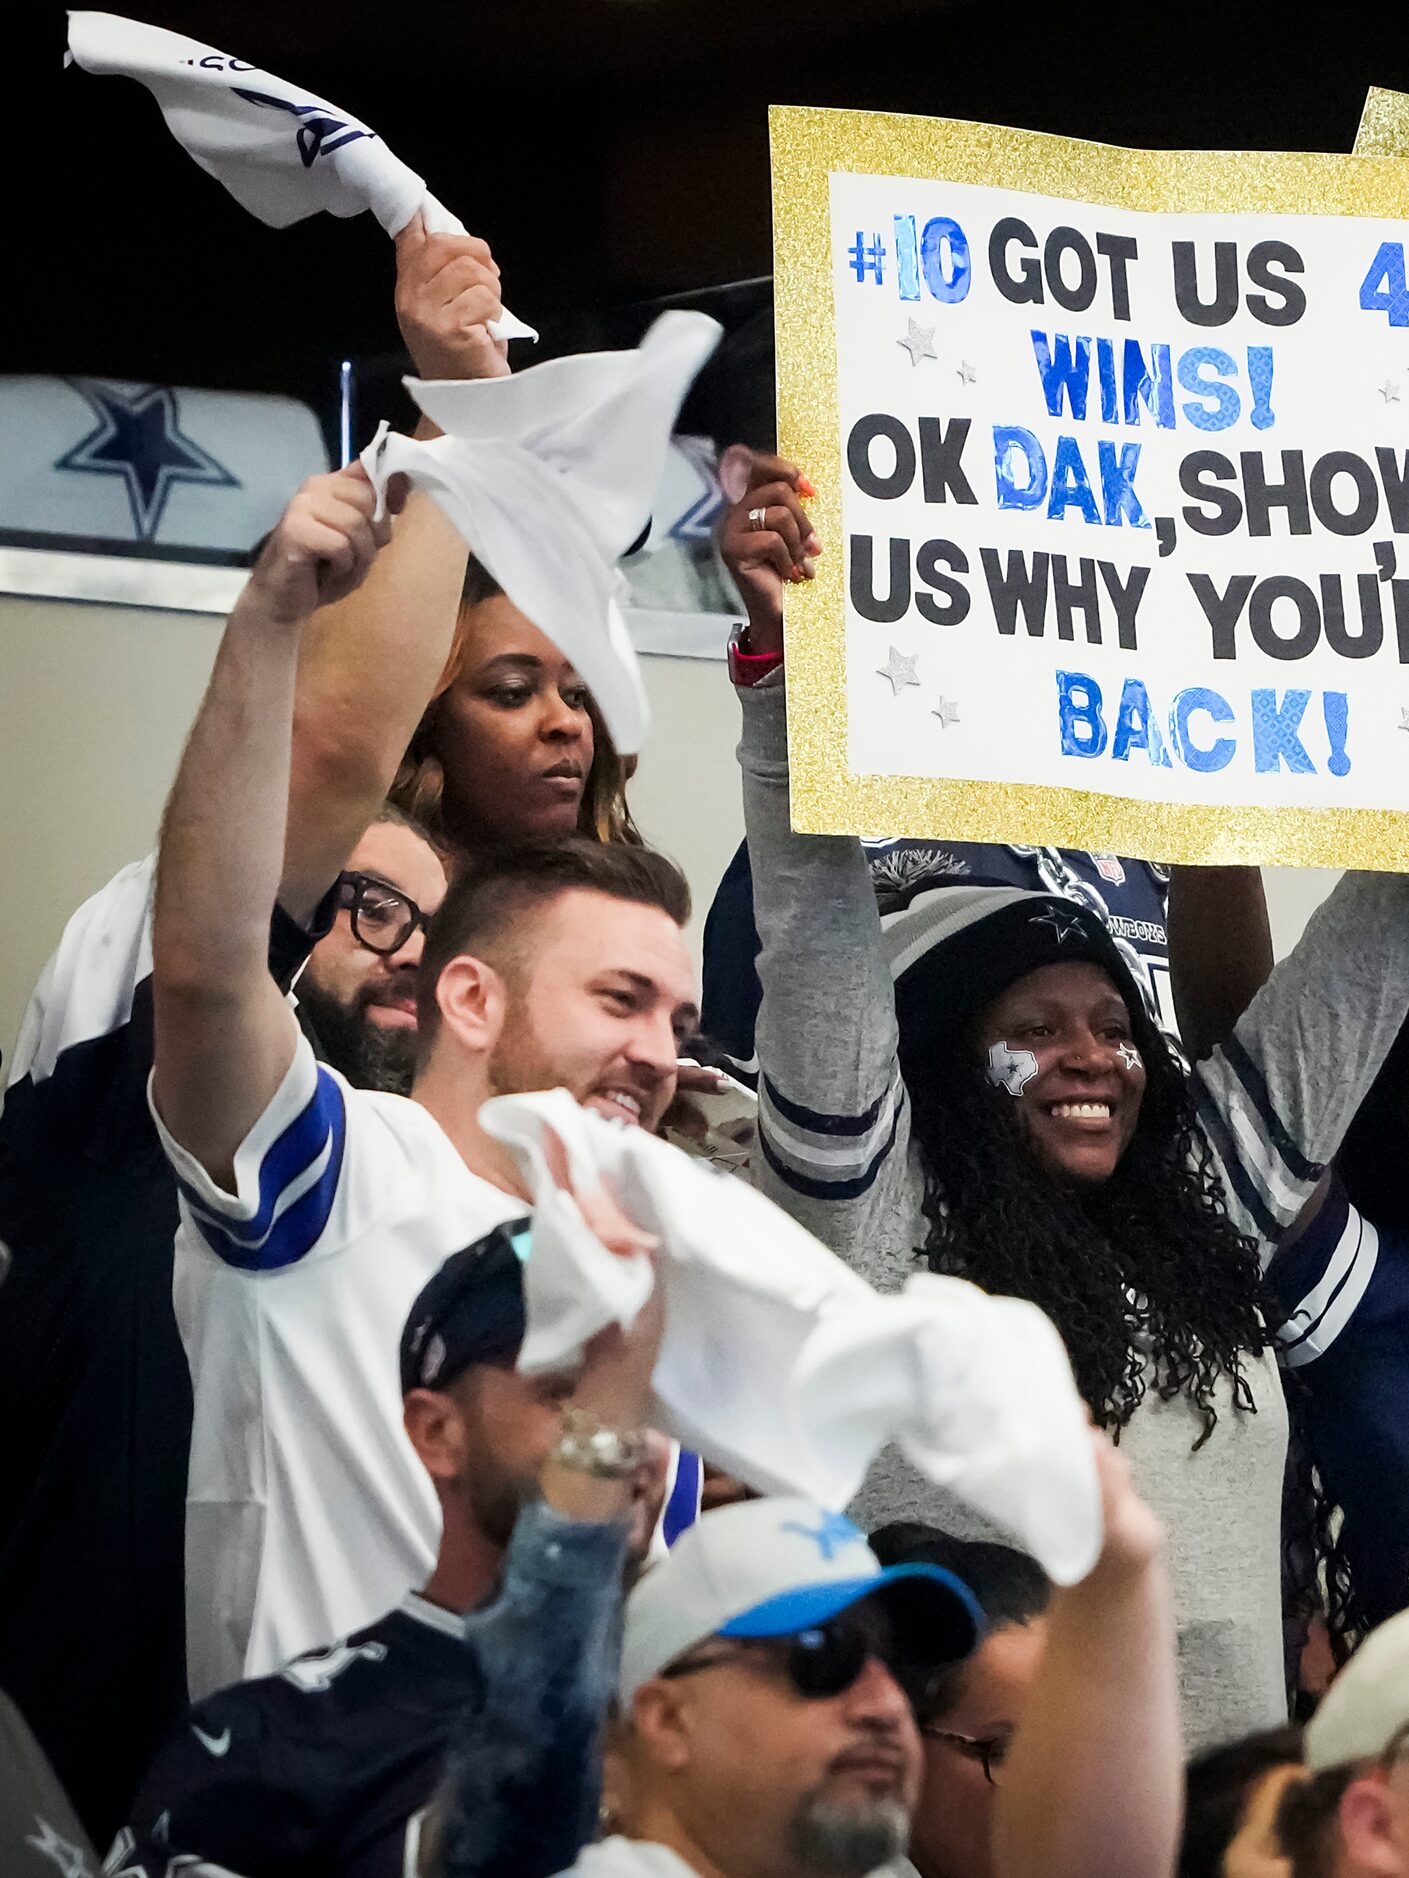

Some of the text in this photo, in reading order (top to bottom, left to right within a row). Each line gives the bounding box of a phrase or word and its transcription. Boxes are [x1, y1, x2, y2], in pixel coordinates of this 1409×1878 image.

[847, 214, 972, 305] #10
[988, 217, 1139, 322] GOT
[1172, 240, 1307, 327] US
[1030, 329, 1276, 431] WINS!
[846, 413, 979, 505] OK
[849, 534, 971, 627] US
[979, 547, 1152, 651] WHY
[1055, 669, 1352, 778] BACK!
